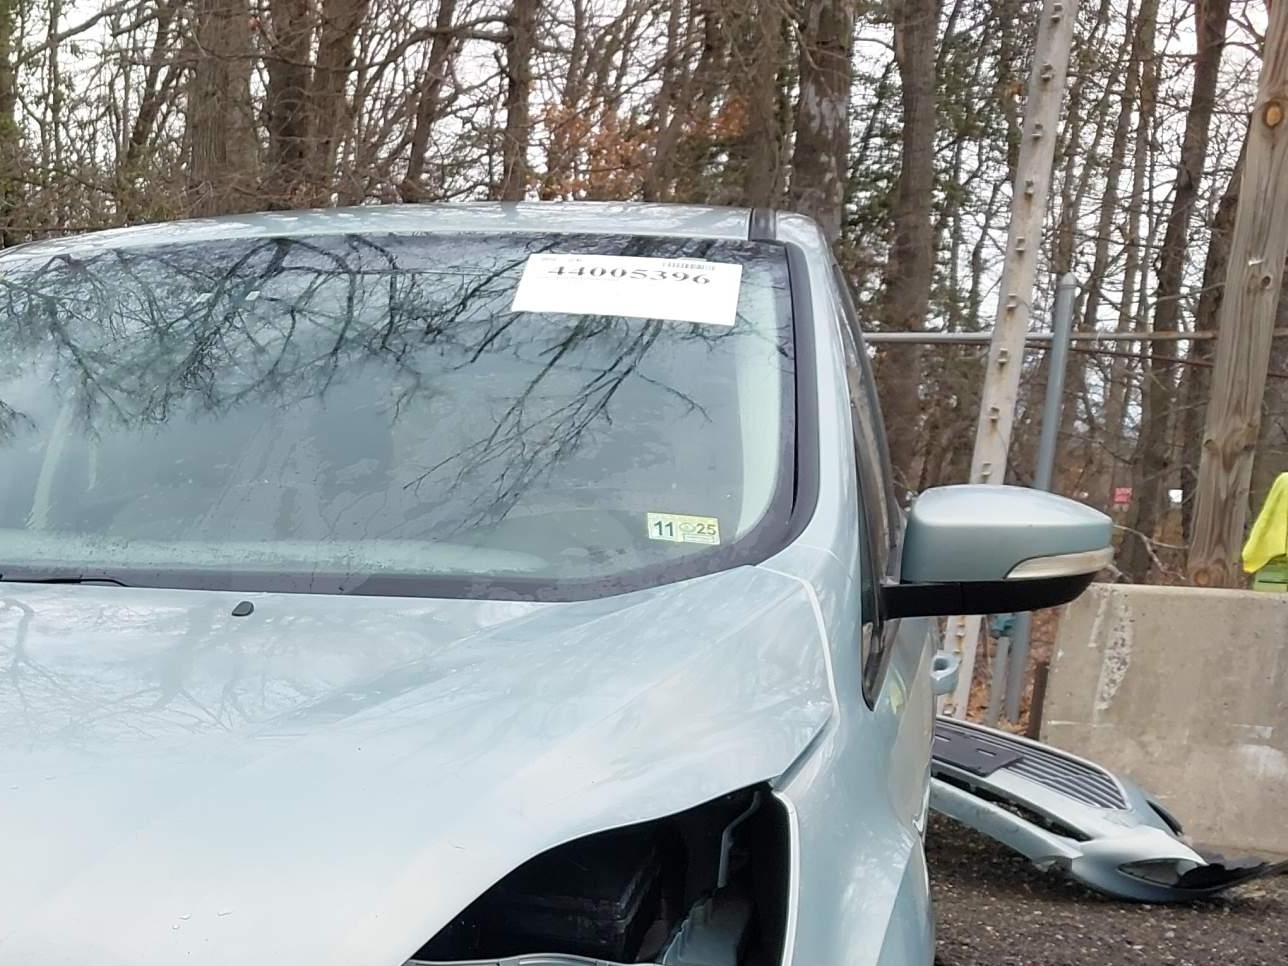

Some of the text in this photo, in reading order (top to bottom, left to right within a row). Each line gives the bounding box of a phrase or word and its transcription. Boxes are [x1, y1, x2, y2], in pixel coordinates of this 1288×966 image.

[548, 265, 711, 286] 44005396
[654, 520, 717, 537] 11 25
